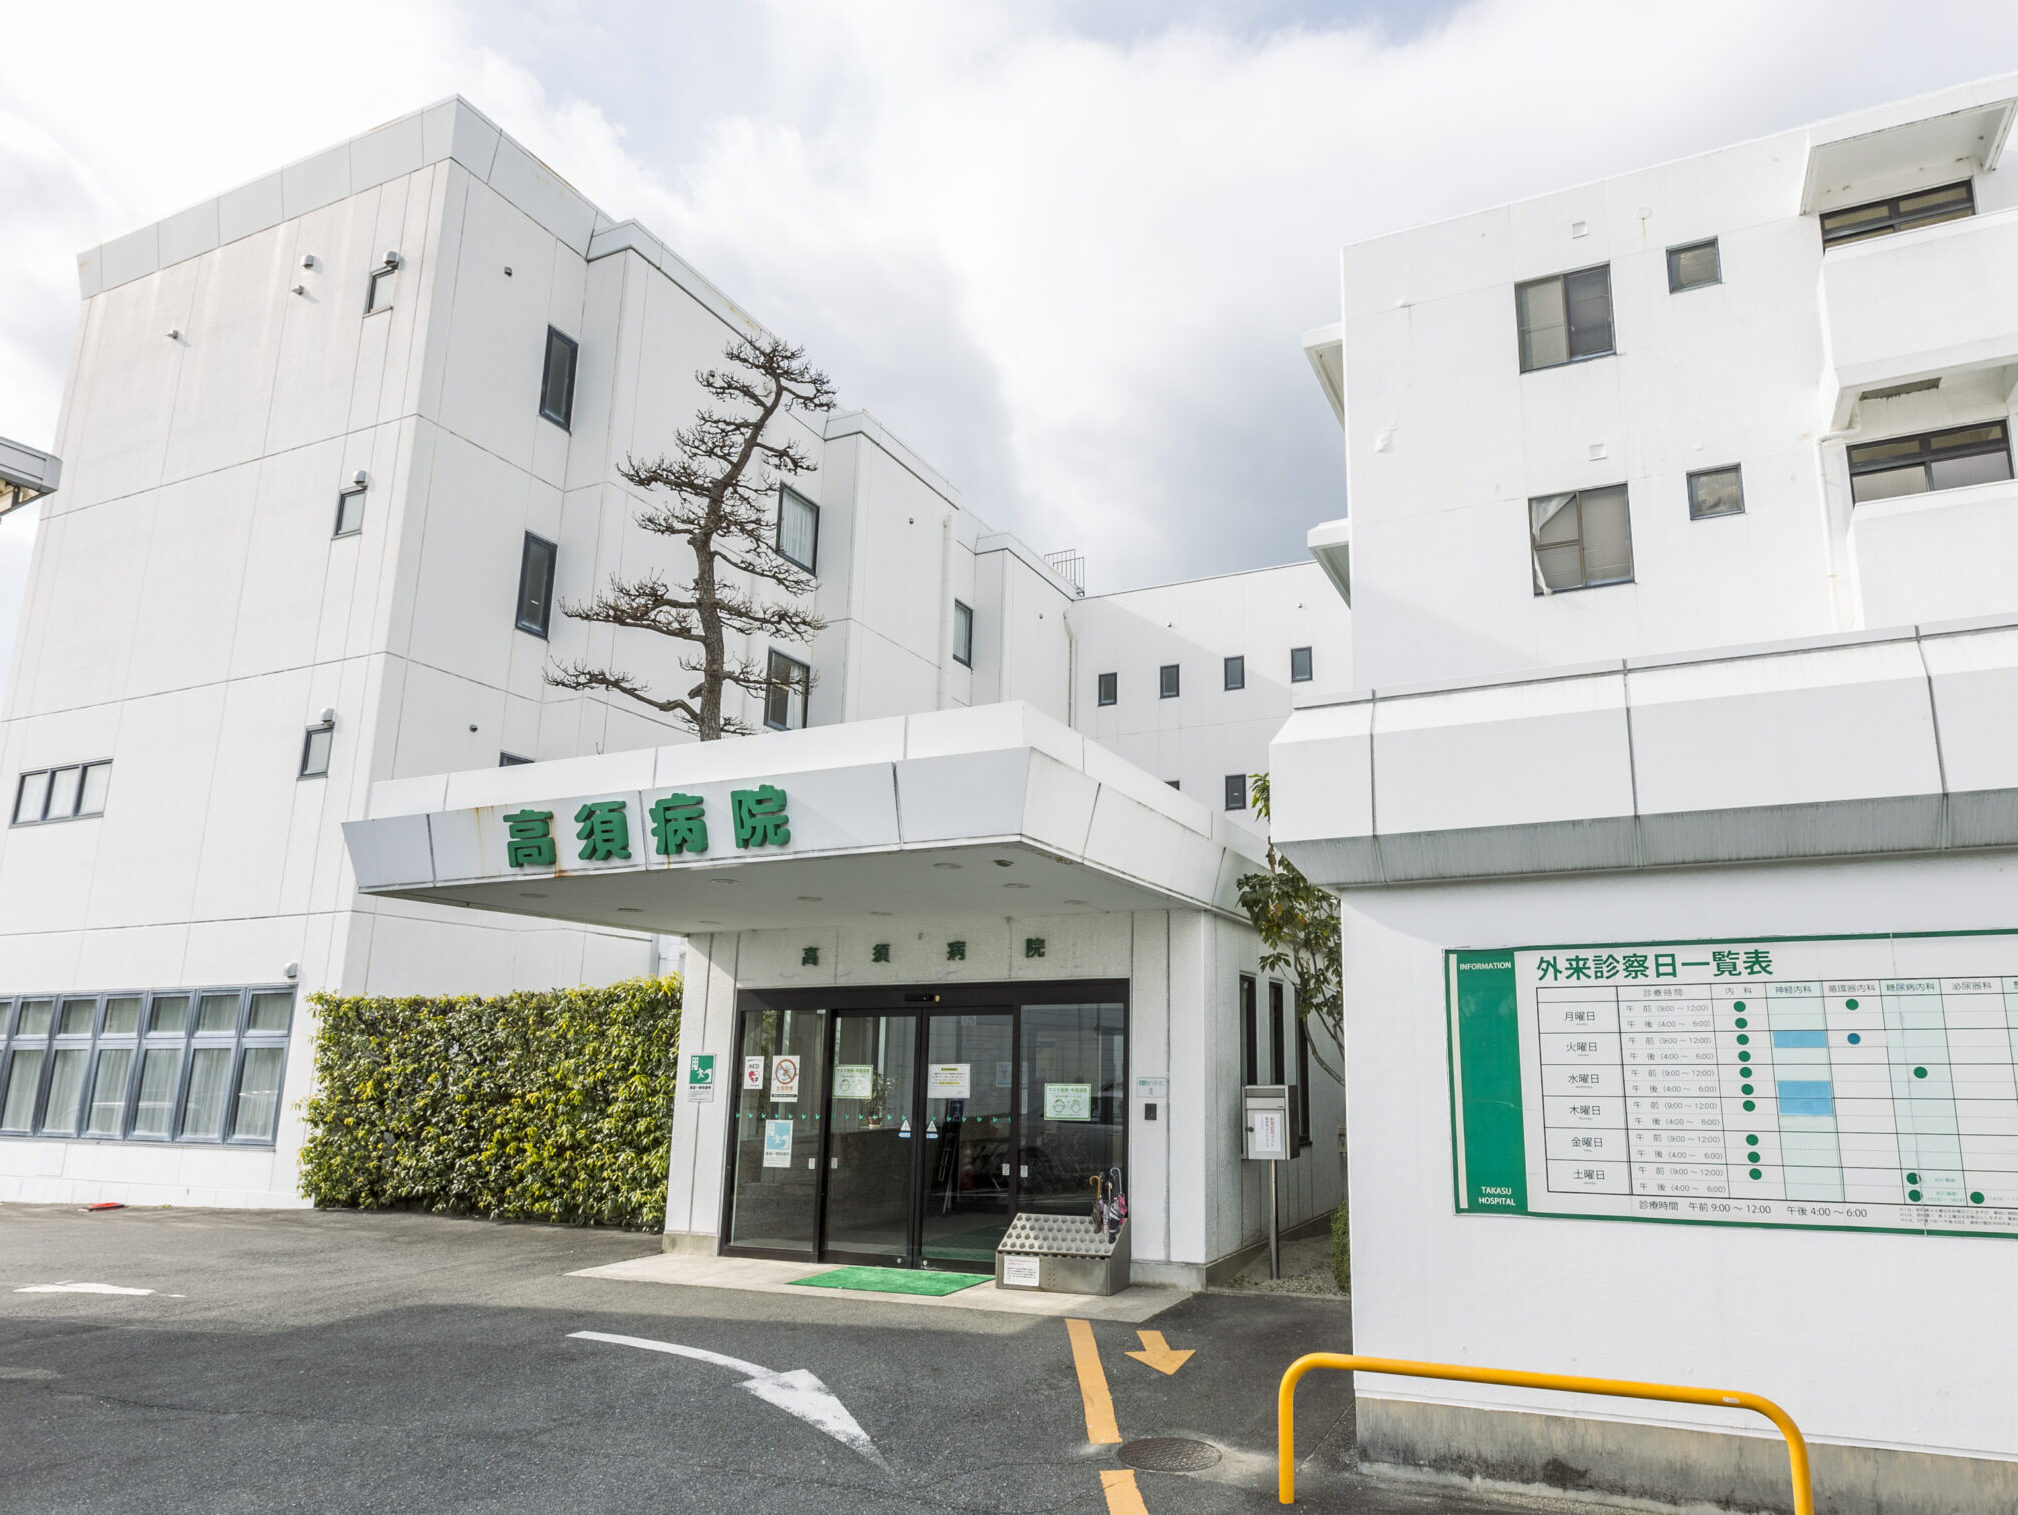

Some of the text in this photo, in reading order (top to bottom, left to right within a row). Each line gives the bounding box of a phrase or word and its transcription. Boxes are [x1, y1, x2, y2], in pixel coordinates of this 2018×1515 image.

[503, 784, 791, 868] 高須病院
[802, 937, 1046, 966] 高須病院
[1460, 962, 1511, 970] INFORMATION
[1536, 949, 1773, 981] 外来診察日一覧表
[1644, 989, 1682, 997] 診療時間
[1776, 986, 1812, 994] 神経内科
[1564, 1011, 1596, 1022] 月曜日
[1566, 1042, 1598, 1052] 火曜日
[1568, 1074, 1600, 1084] 水曜日
[1570, 1105, 1600, 1116] 木曜日
[1571, 1137, 1602, 1148] 金曜日
[1573, 1169, 1605, 1180] 土曜日
[1481, 1186, 1512, 1195] TAKASU
[1478, 1196, 1516, 1206] HOSPITAL
[1639, 1201, 1678, 1211] 診療時間
[1689, 1202, 1709, 1212] 午前
[1711, 1204, 1730, 1213] 9:00
[1747, 1205, 1771, 1214] 12:00
[1787, 1206, 1807, 1216] 午後
[1810, 1208, 1830, 1216] 4:00
[1847, 1209, 1867, 1217] 6:00
